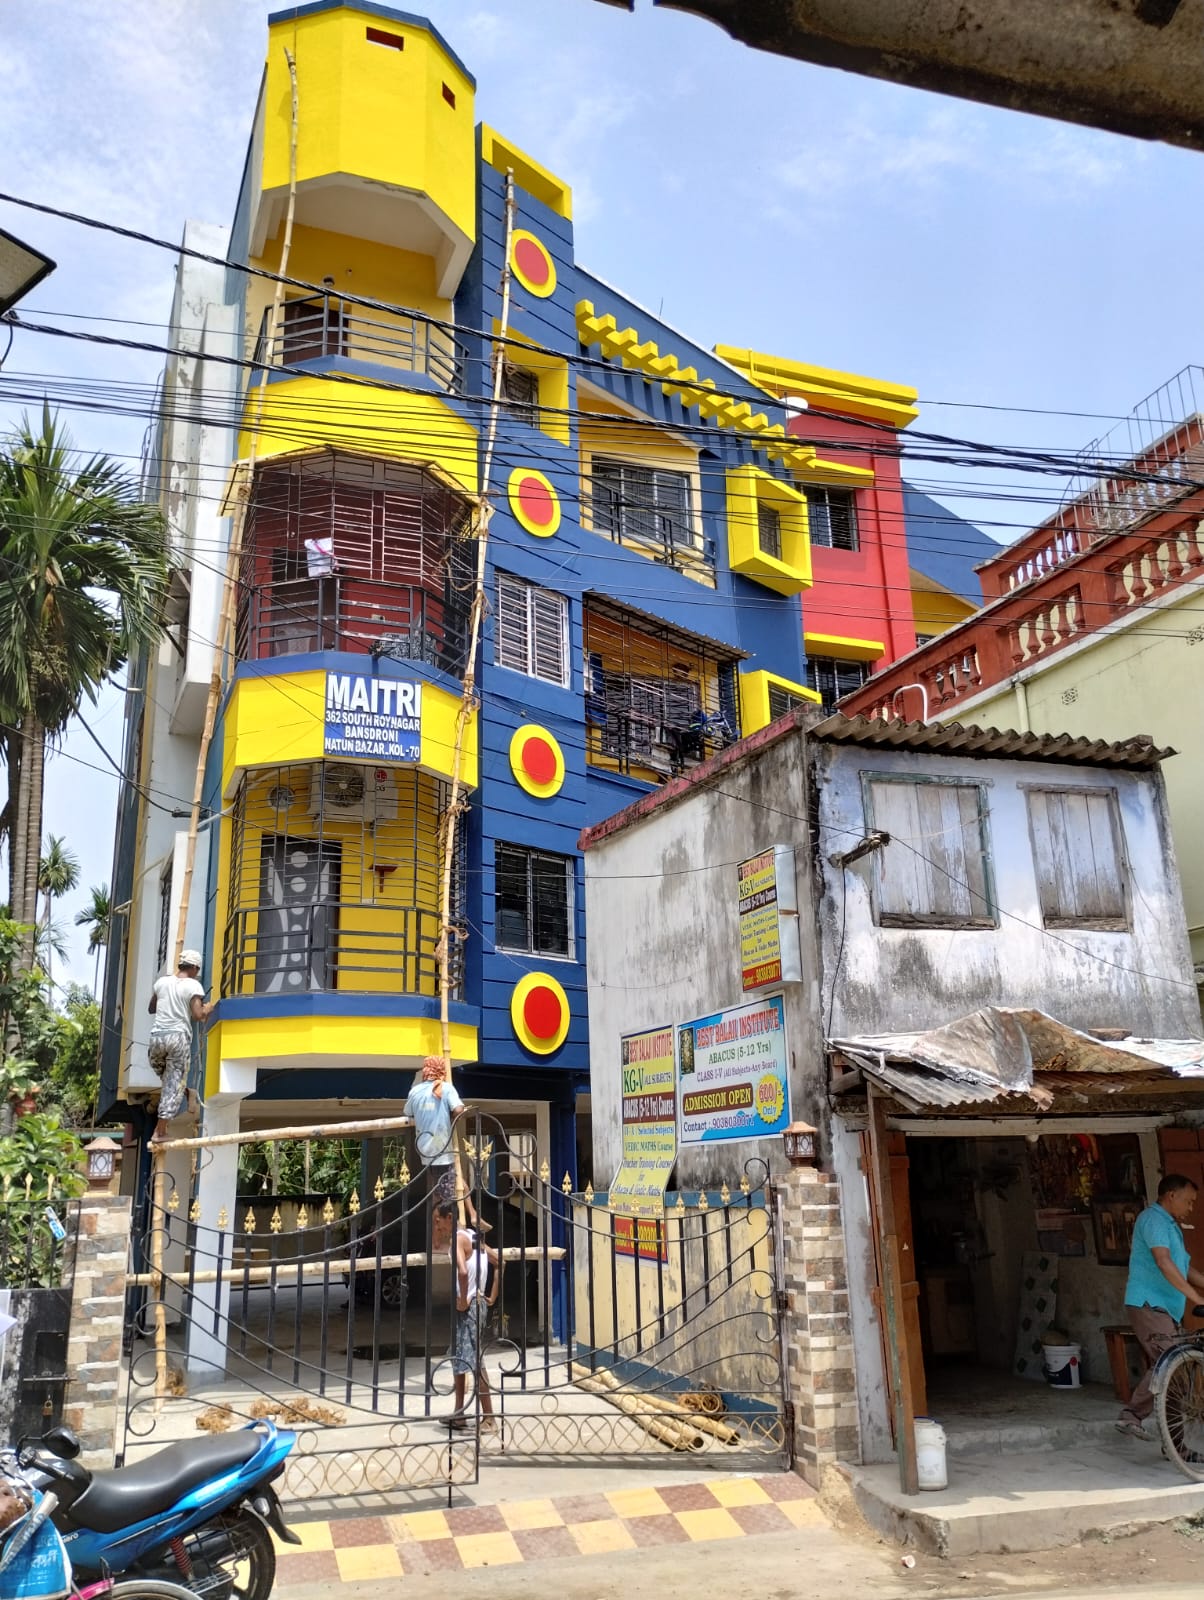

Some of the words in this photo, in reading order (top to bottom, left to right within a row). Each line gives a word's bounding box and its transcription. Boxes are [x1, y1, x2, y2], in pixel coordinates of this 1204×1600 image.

[327, 674, 421, 718] MAITRI
[325, 711, 341, 724] 362
[342, 712, 372, 726] SOUTH
[345, 726, 398, 743] BANSDRONI
[325, 737, 354, 752] NATUN
[697, 1026, 714, 1048] BEST
[739, 1007, 780, 1038] INSTITUTE
[708, 1048, 736, 1064] ABACUS
[737, 1044, 755, 1061] (5-12
[757, 1040, 772, 1055] Yrs)
[624, 1067, 644, 1093] KG-V
[697, 1069, 713, 1082] CLASS
[685, 1091, 727, 1112] ADMISSION
[728, 1088, 752, 1105] OPEN
[763, 1106, 777, 1117] Only
[683, 1120, 707, 1132] Contact
